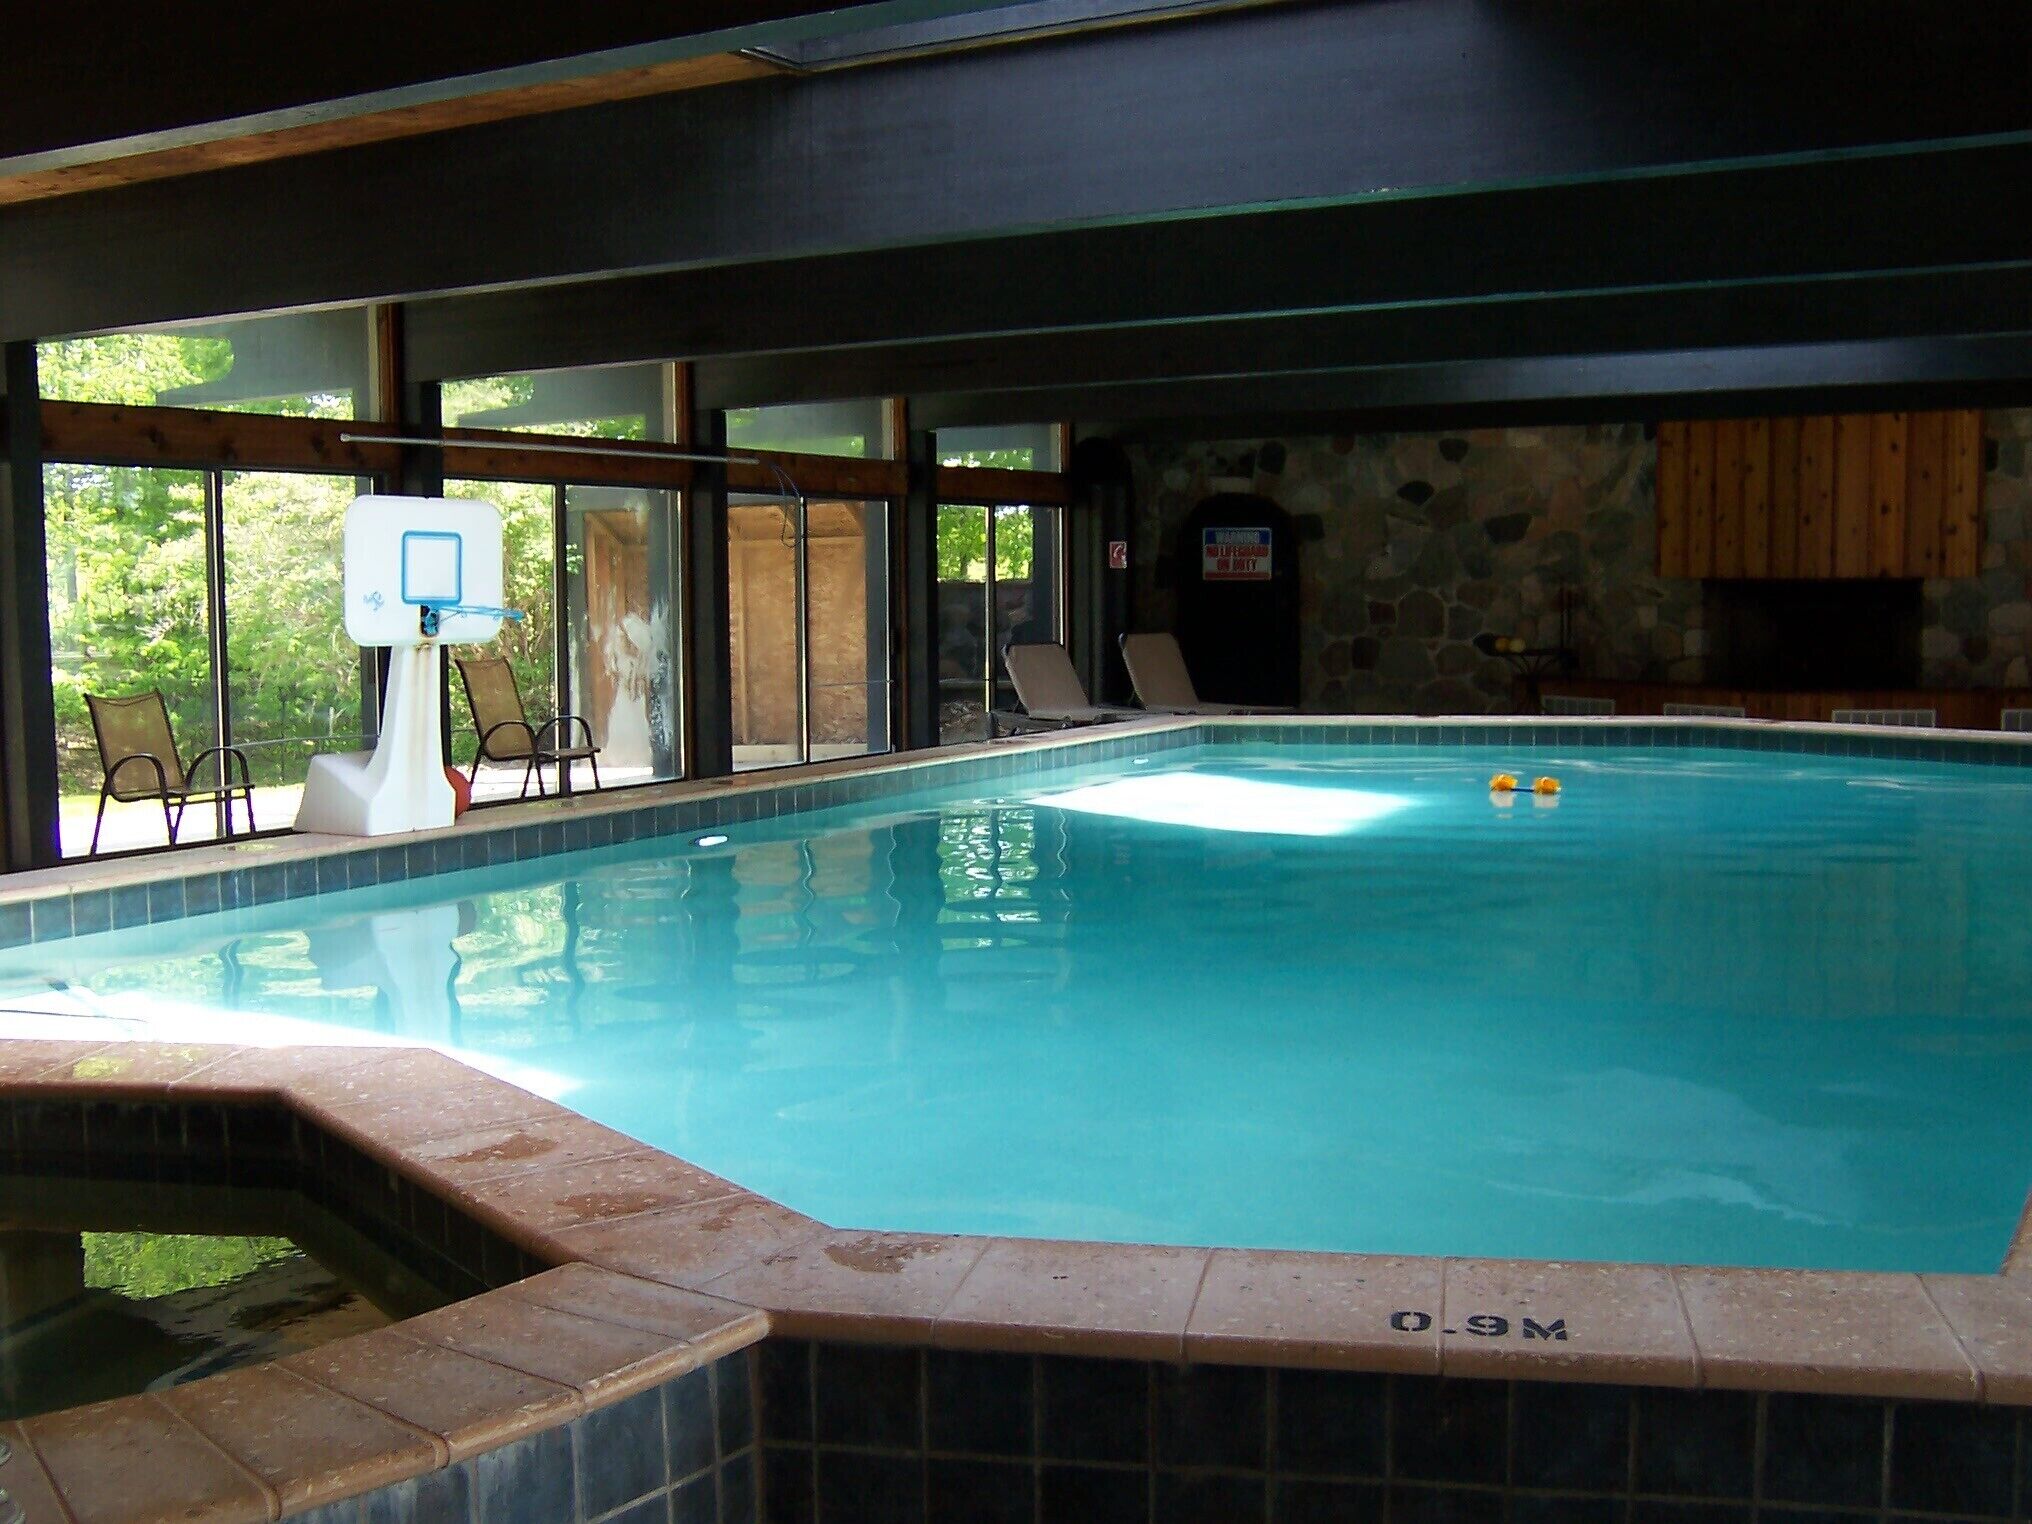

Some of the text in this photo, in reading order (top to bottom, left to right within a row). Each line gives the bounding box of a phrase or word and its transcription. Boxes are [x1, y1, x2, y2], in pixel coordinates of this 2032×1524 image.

[1206, 545, 1268, 557] NO LIFEGUARD
[1217, 559, 1257, 571] ON DUTY
[1390, 1311, 1568, 1341] 0.9M
